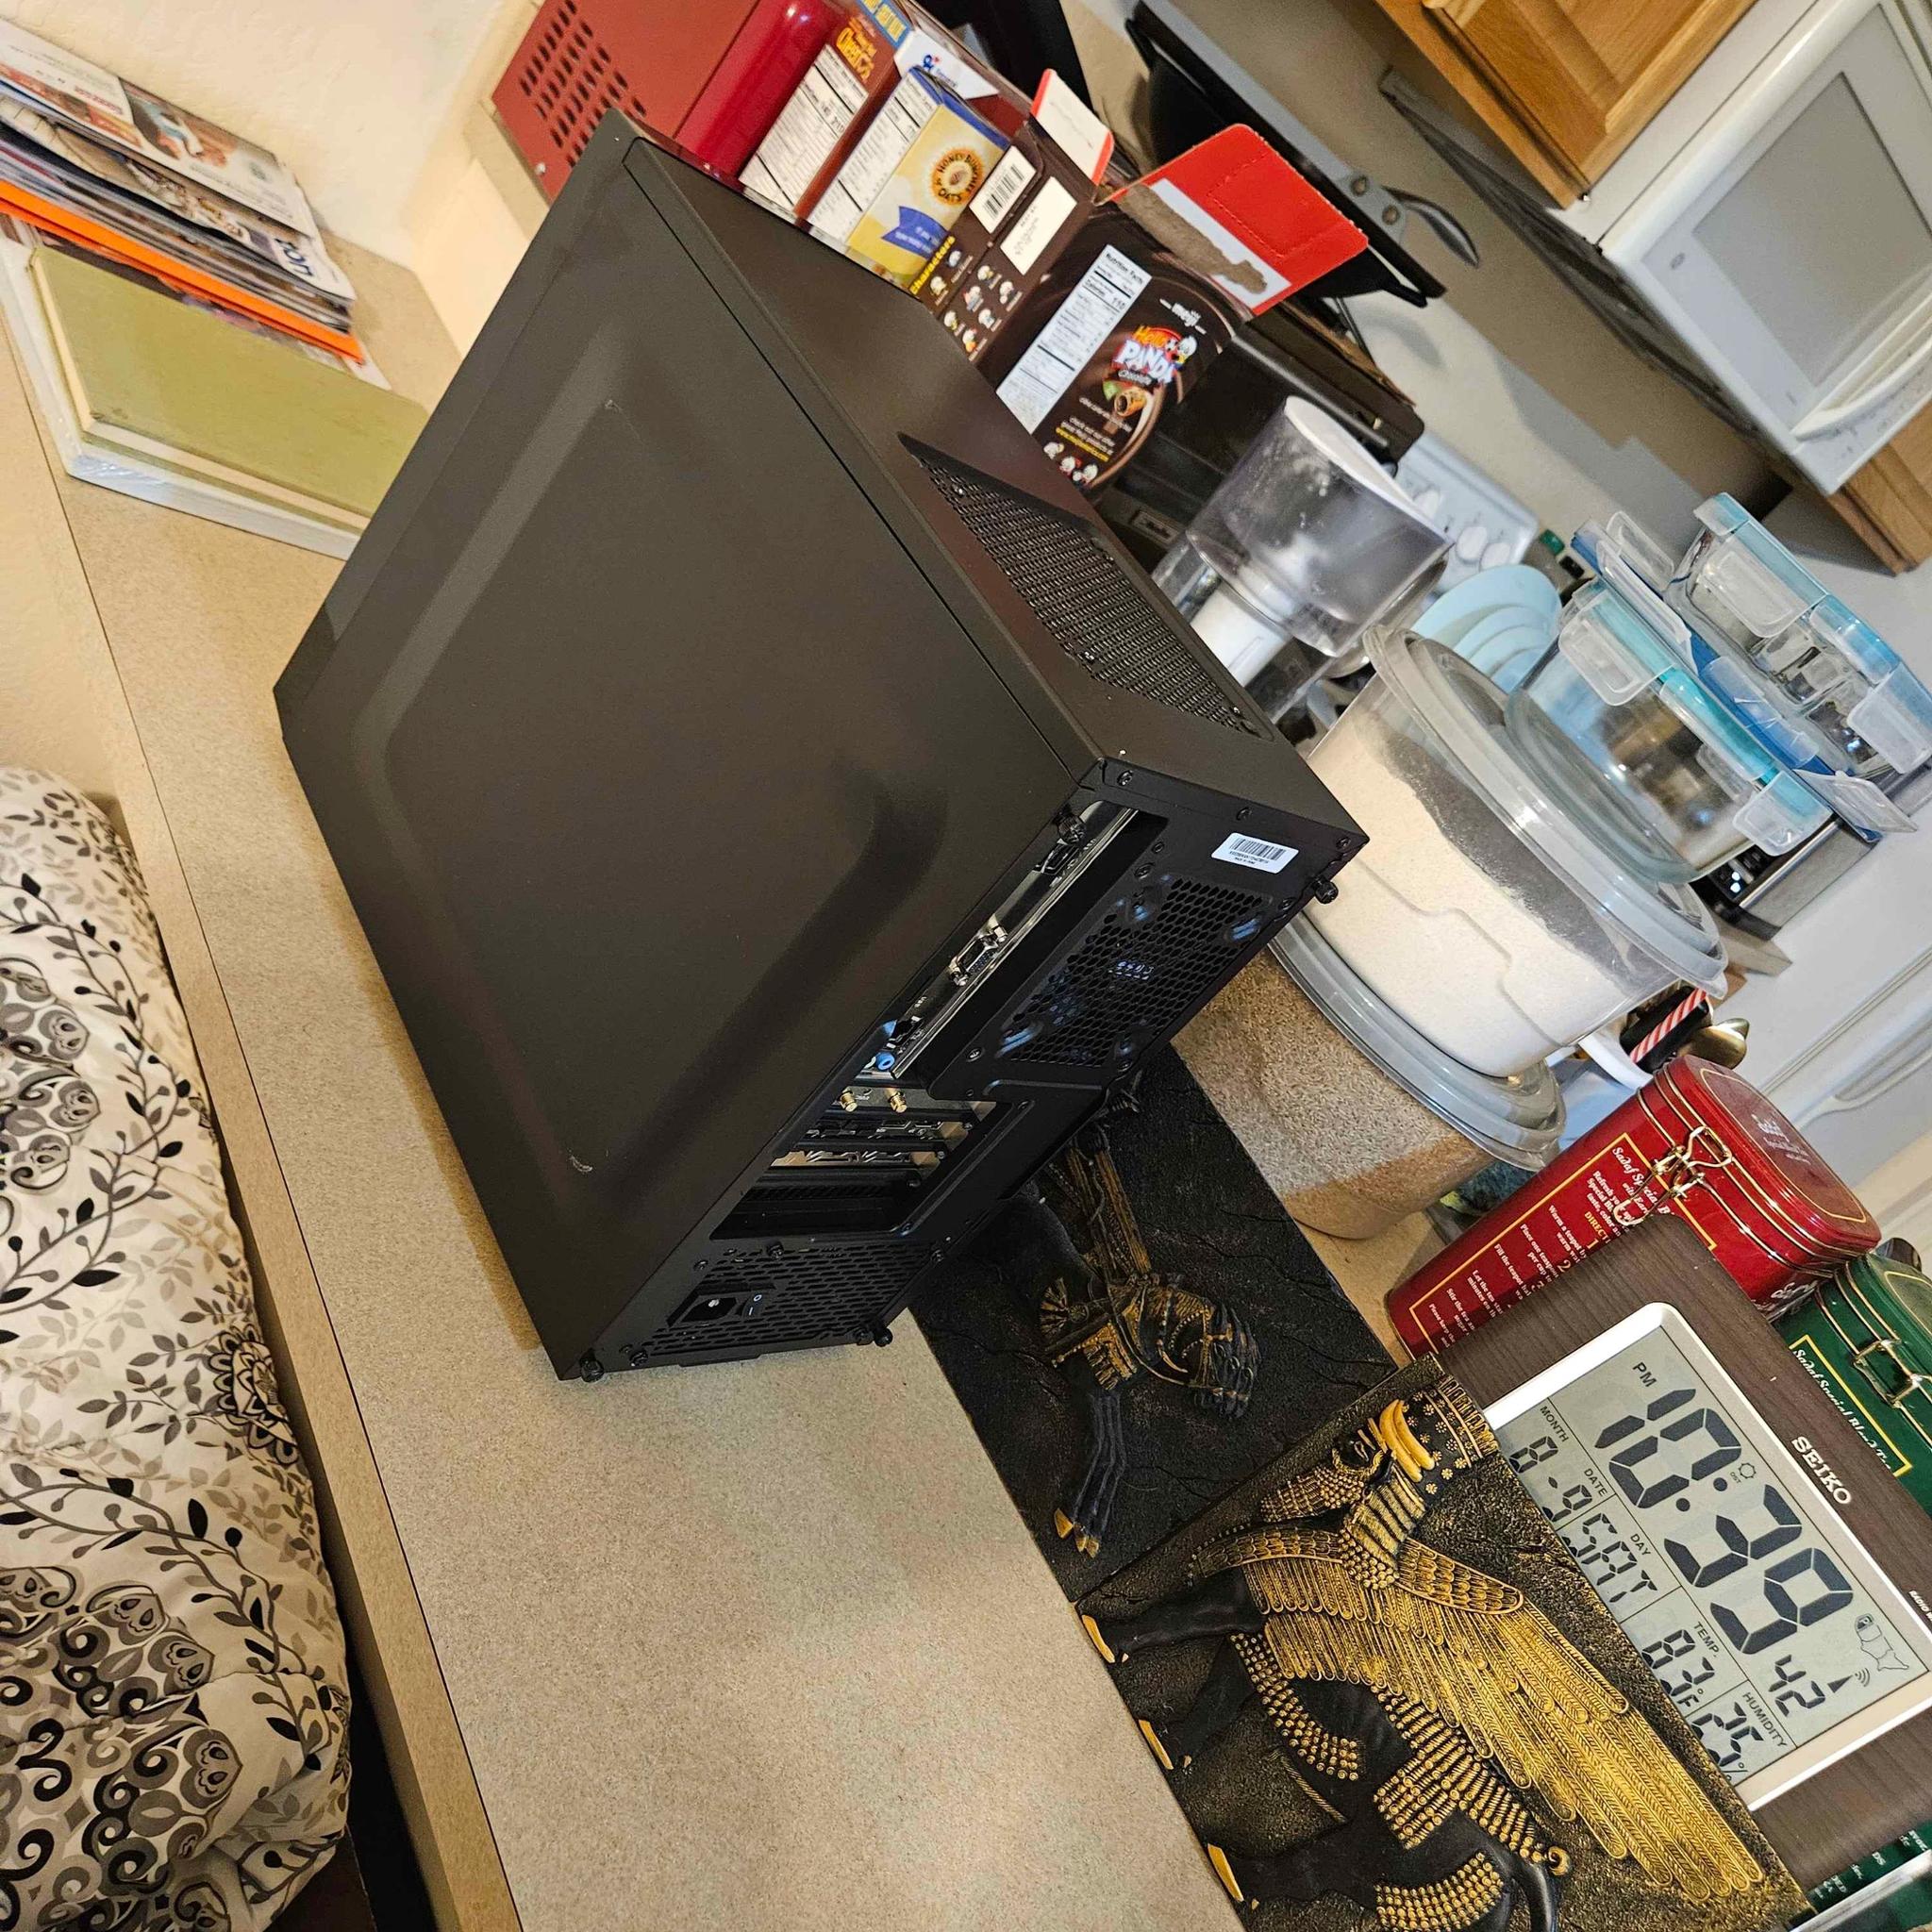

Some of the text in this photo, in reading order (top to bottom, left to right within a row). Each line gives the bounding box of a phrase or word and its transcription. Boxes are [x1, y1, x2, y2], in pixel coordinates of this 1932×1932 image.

[1114, 339, 1175, 384] PANDA
[1612, 1147, 1640, 1174] Sadaf
[1587, 1177, 1607, 1203] Special
[1593, 1171, 1614, 1196] Refresh
[1610, 1195, 1625, 1211] yor
[1587, 1192, 1601, 1212] taste,
[1600, 1210, 1614, 1226] color
[1520, 1224, 1534, 1241] Place
[1531, 1241, 1541, 1253] one
[1548, 1205, 1564, 1226] Warm
[1565, 1229, 1582, 1251] teapot
[1557, 1231, 1571, 1251] warm
[1586, 1239, 1599, 1249] 1
[1493, 1243, 1505, 1256] Fill
[1501, 1255, 1510, 1267] the
[1507, 1265, 1524, 1286] teapot
[1527, 1252, 1539, 1262] per
[1536, 1263, 1547, 1275] cup
[1557, 1259, 1572, 1273] 2
[1446, 1288, 1457, 1301] Stir
[1454, 1300, 1463, 1312] the
[1467, 1276, 1485, 1302] minutes
[1483, 1301, 1491, 1310] on
[1473, 1270, 1482, 1282] Let
[1479, 1281, 1489, 1293] the
[1486, 1291, 1495, 1302] tea
[1429, 1303, 1441, 1321] Please
[1632, 1361, 1657, 1388] PM
[1729, 1472, 1742, 1484] DST
[1791, 1436, 1852, 1506] SEIKO
[1594, 1389, 1853, 1655] 10:39
[1562, 1512, 1657, 1603] SAT
[1539, 1405, 1789, 1748] MONTH DATE DAY TEMP. HUMIDITY
[1908, 1590, 1928, 1613] RADIO
[1768, 1654, 1826, 1717] 42
